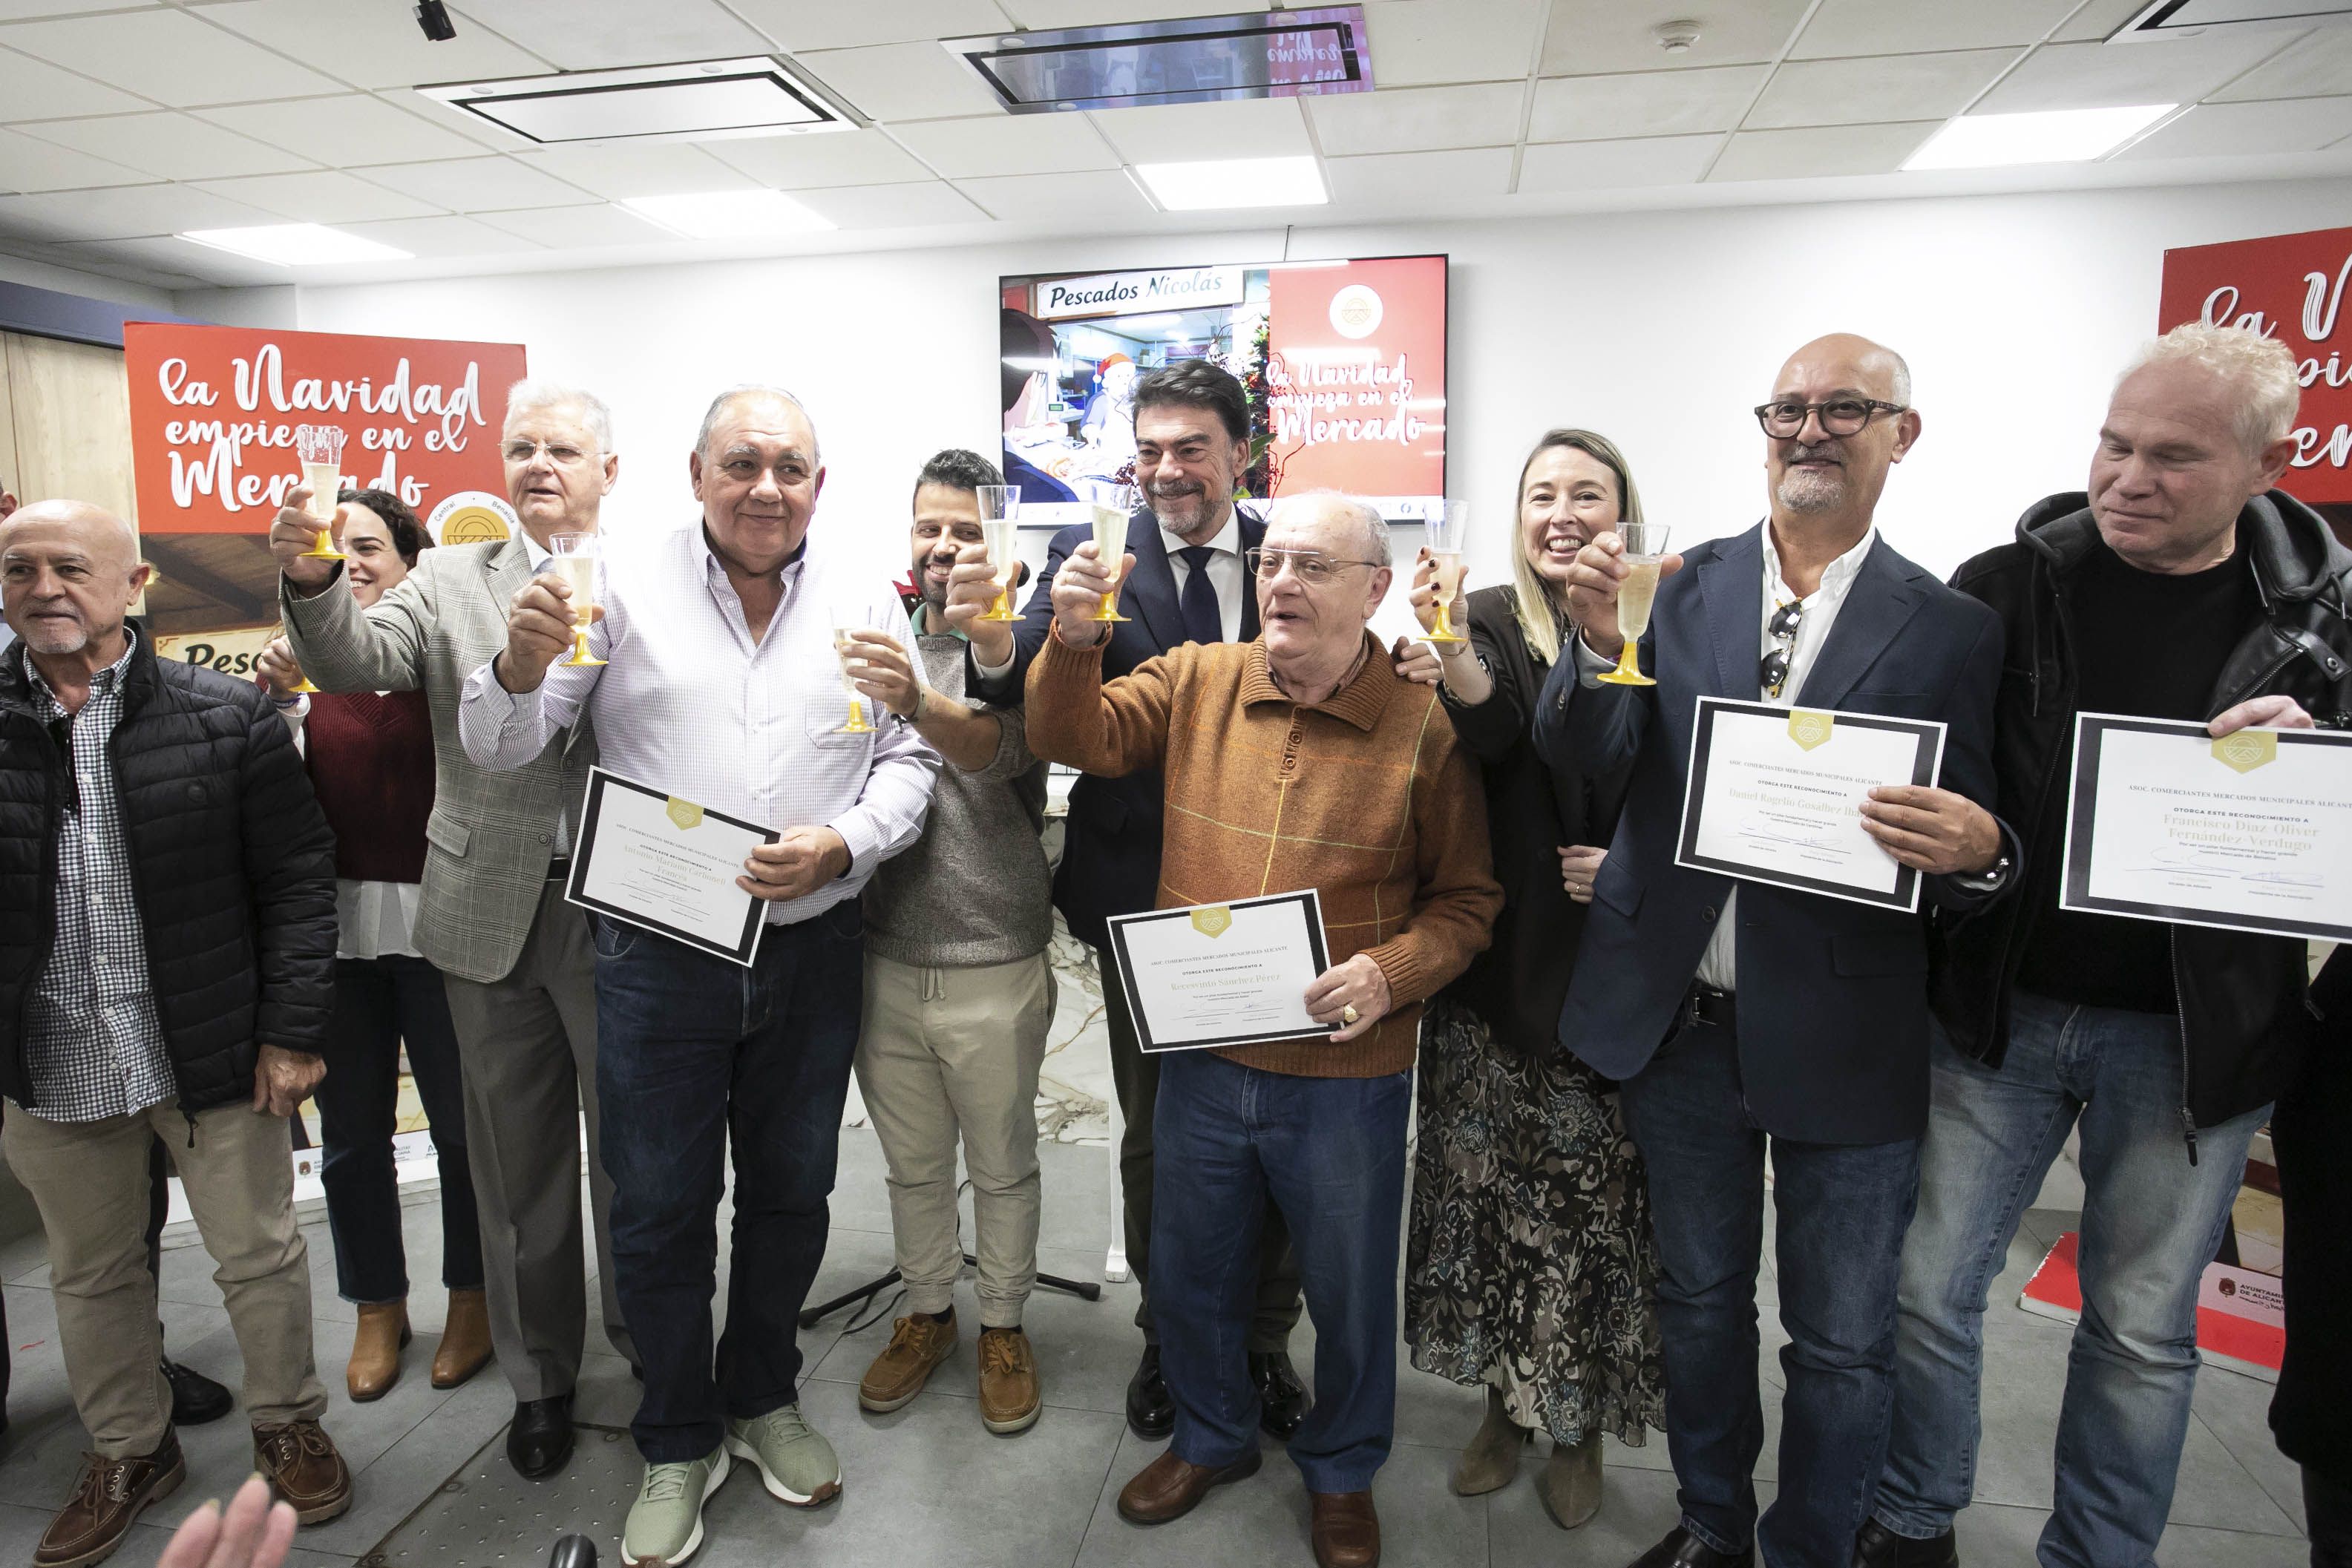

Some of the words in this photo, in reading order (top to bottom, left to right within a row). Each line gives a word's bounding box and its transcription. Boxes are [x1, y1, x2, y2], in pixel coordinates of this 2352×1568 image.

[1050, 281, 1138, 308] Pescados
[1146, 271, 1222, 298] Nicolás
[1299, 353, 1407, 387] Navidad
[232, 344, 486, 426] Navidad
[1267, 391, 1353, 413] empieza
[1358, 391, 1384, 405] en
[1389, 378, 1414, 404] el
[361, 427, 412, 452] en
[425, 410, 468, 453] el
[1277, 405, 1426, 446] Mercado
[434, 501, 456, 522] Central
[1785, 767, 1815, 776] MERCADOS
[1815, 771, 1853, 781] MUNICIPALES
[1855, 777, 1882, 786] ALICANTE
[1794, 785, 1841, 796] RECONOCIMIENTO
[2151, 787, 2209, 798] COMERCIANTES
[2214, 792, 2256, 801] MERCADOS
[2259, 796, 2314, 807] MUNICIPALES
[2318, 801, 2352, 810] ALICANT
[2163, 813, 2230, 830] Francisco
[2228, 812, 2300, 823] RECONOCIMIENTO
[1215, 963, 1257, 972] RECONOCIMIENTO
